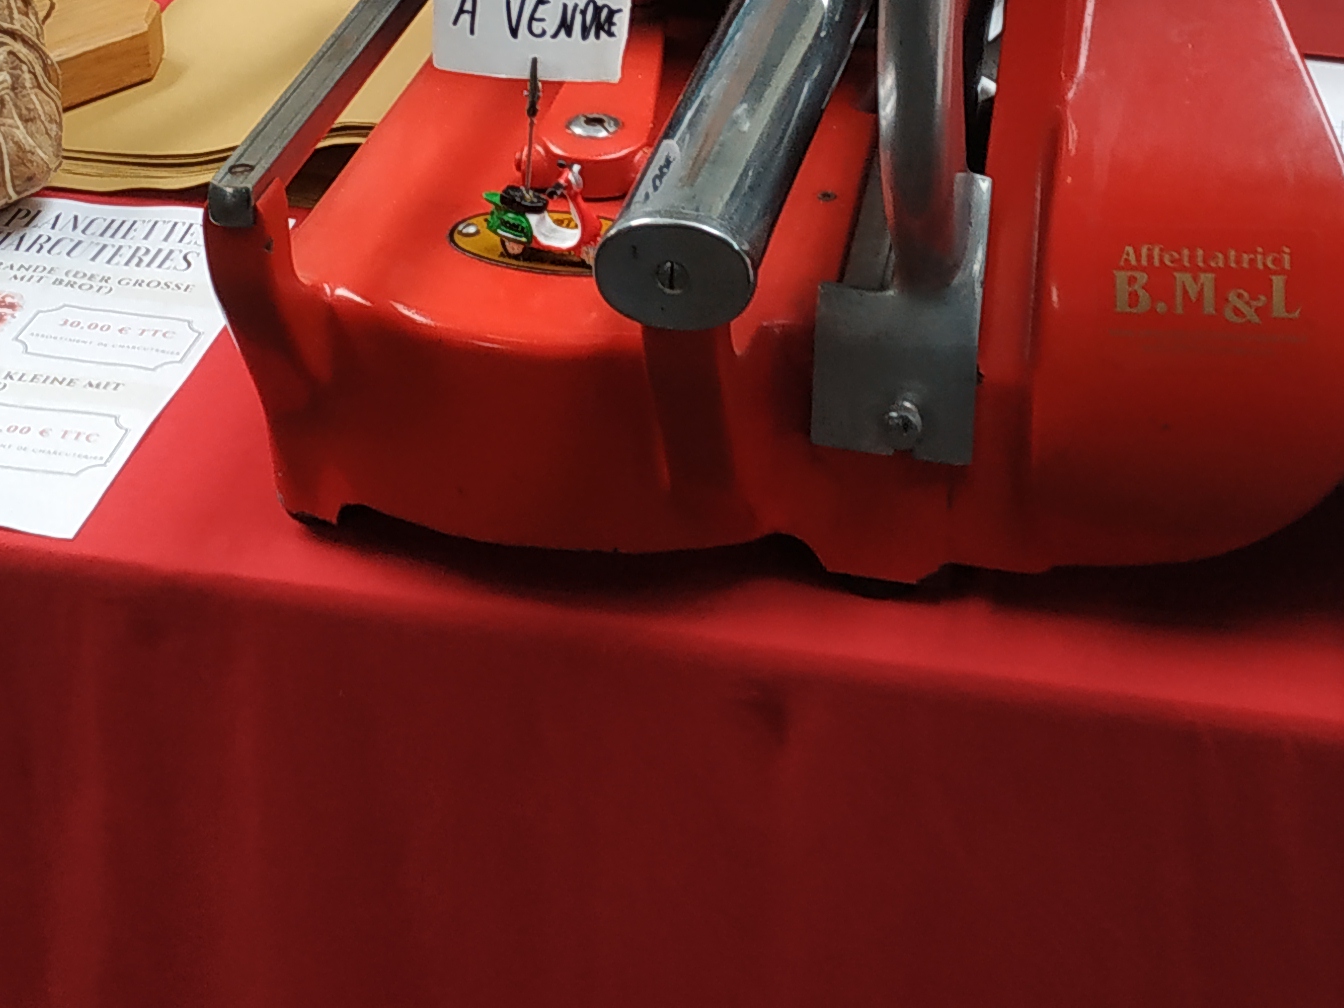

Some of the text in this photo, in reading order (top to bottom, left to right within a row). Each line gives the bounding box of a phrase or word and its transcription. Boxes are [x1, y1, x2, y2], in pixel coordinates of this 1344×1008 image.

[1119, 243, 1292, 271] Affettatrici
[8, 272, 114, 295] MIT BROT)
[64, 268, 112, 285] (DER
[117, 277, 196, 294] GROSSE
[1112, 269, 1303, 324] B.M&L
[117, 325, 132, 336] €
[137, 327, 177, 340] TTC
[2, 370, 76, 389] KLEINE
[82, 379, 125, 392] MIT
[38, 427, 53, 438] €
[60, 428, 100, 444] TTC
